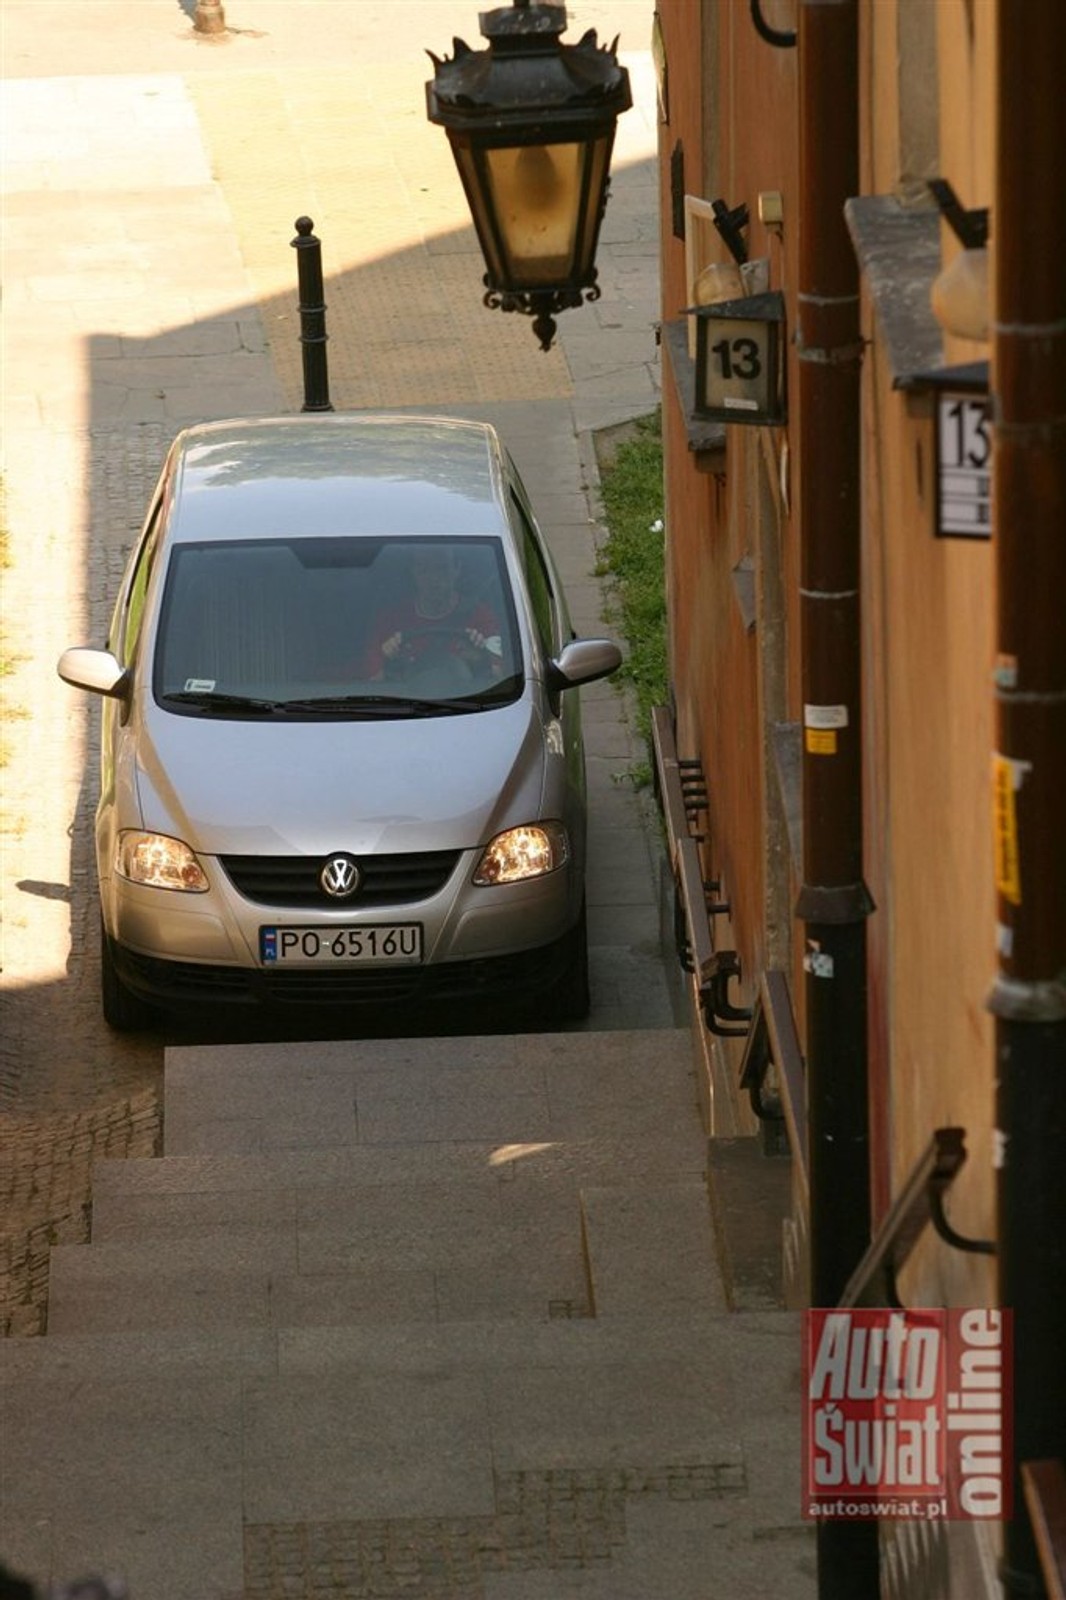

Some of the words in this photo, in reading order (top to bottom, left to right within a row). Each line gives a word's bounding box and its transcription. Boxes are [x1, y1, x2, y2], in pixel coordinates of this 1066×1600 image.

[712, 338, 762, 380] 13
[949, 400, 990, 468] 13
[281, 931, 320, 957] PO
[331, 929, 416, 957] 6516U
